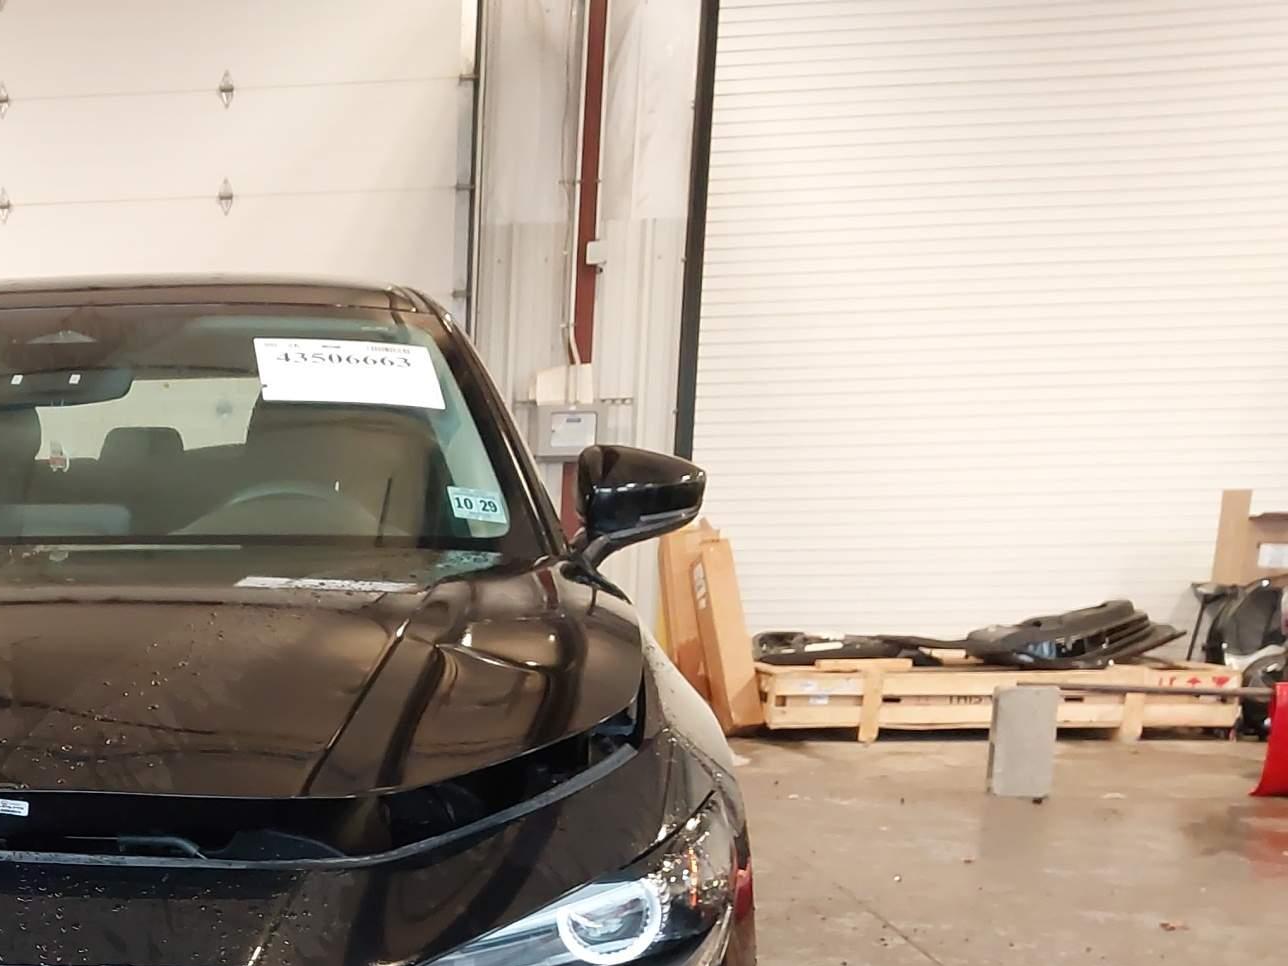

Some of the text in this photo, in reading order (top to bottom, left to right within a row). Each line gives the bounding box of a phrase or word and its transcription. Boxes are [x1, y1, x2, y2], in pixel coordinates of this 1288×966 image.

[276, 351, 412, 368] 43506663
[455, 496, 473, 510] 10
[479, 499, 498, 513] 29
